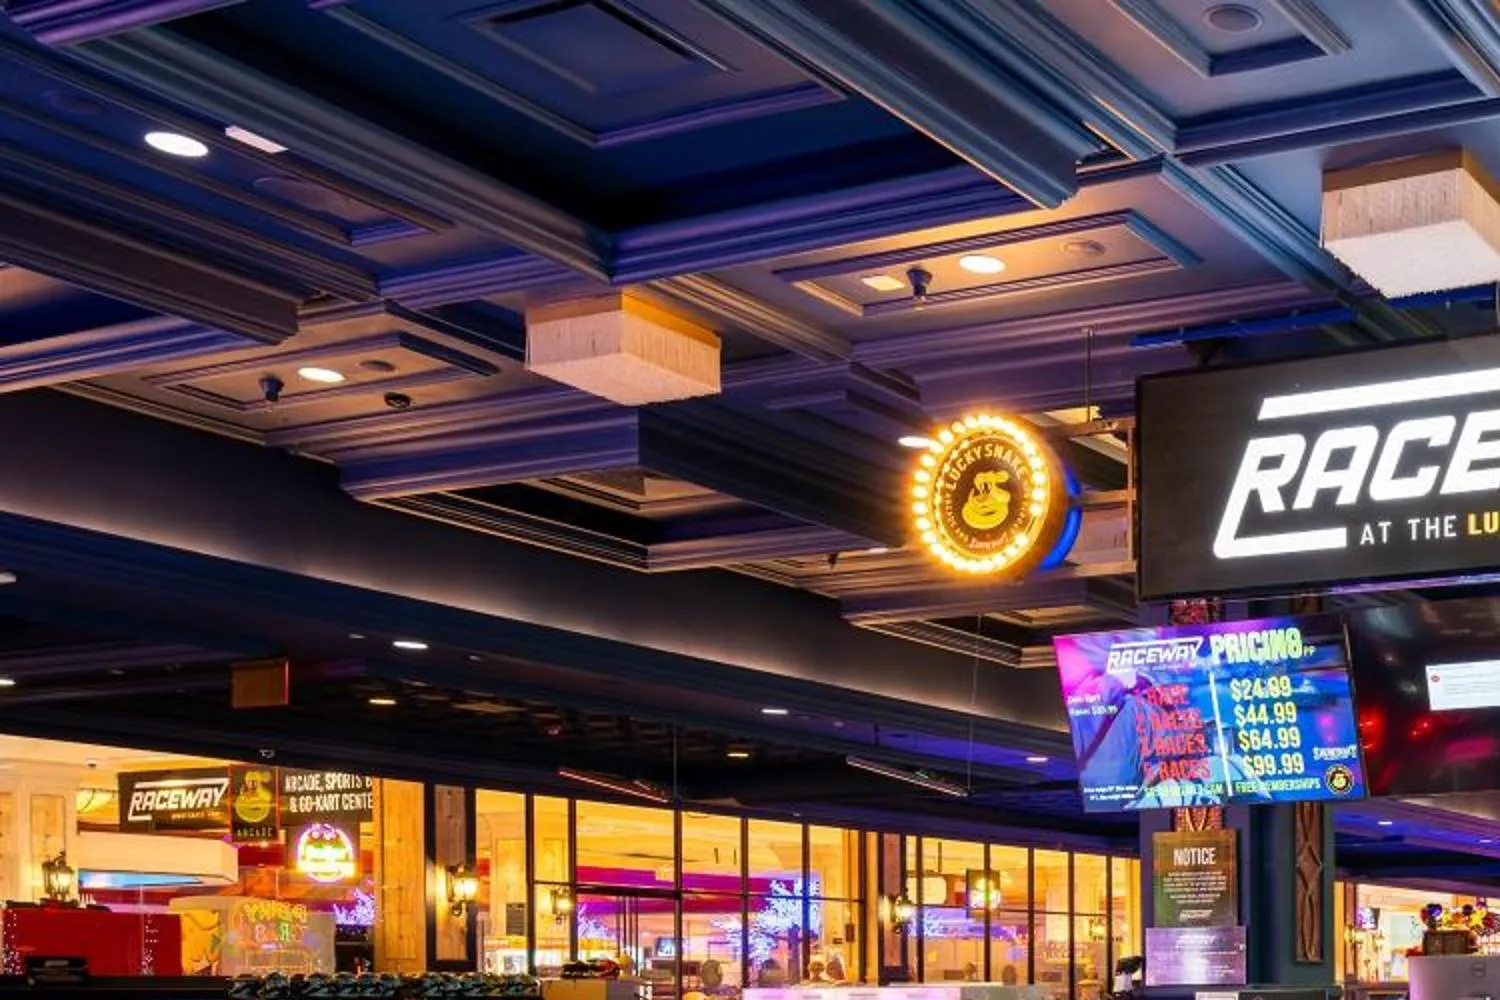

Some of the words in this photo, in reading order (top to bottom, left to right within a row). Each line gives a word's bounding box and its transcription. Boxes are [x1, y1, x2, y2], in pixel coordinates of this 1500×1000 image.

[945, 445, 981, 490] LUCKY
[984, 444, 1029, 480] SNAKE
[1359, 521, 1393, 546] AT
[1408, 514, 1458, 540] THE
[1106, 643, 1202, 671] RACEWAY
[1209, 628, 1304, 664] PRICING
[1230, 675, 1292, 702] $24.99
[1234, 701, 1297, 728] $44.99
[1238, 726, 1302, 752] $64.99
[1243, 752, 1305, 777] $99.99
[325, 772, 363, 790] SPORTS
[131, 786, 227, 811] RACEWAY
[298, 794, 338, 813] GO-KART
[341, 791, 373, 809] CENTE
[1173, 847, 1217, 865] NOTICE
